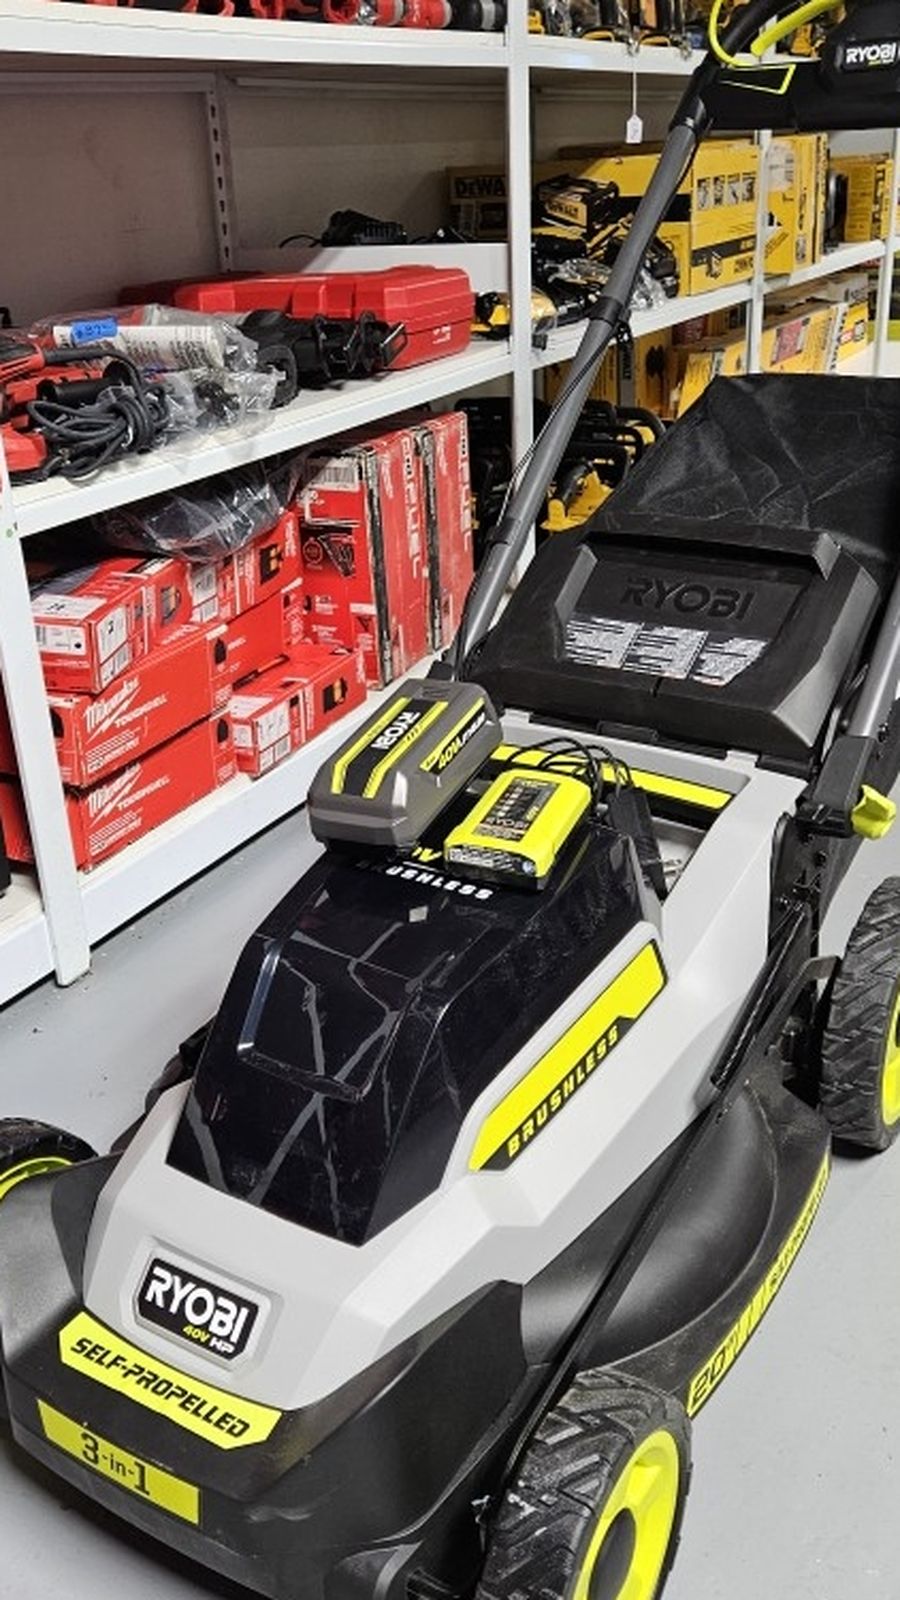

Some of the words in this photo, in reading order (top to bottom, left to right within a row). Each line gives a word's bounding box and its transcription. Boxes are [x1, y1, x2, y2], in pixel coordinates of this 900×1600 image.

[846, 43, 896, 64] RYOBI
[454, 176, 507, 197] DEWA
[620, 576, 755, 620] RYOBI
[370, 711, 421, 750] RYOBI
[507, 1024, 619, 1158] BRUSHLESS
[145, 1266, 249, 1344] RYOBI
[182, 1325, 209, 1344] 40V
[208, 1335, 236, 1355] HP
[70, 1337, 250, 1438] SELF-PROPELLED
[80, 1432, 151, 1496] 3-in-1
